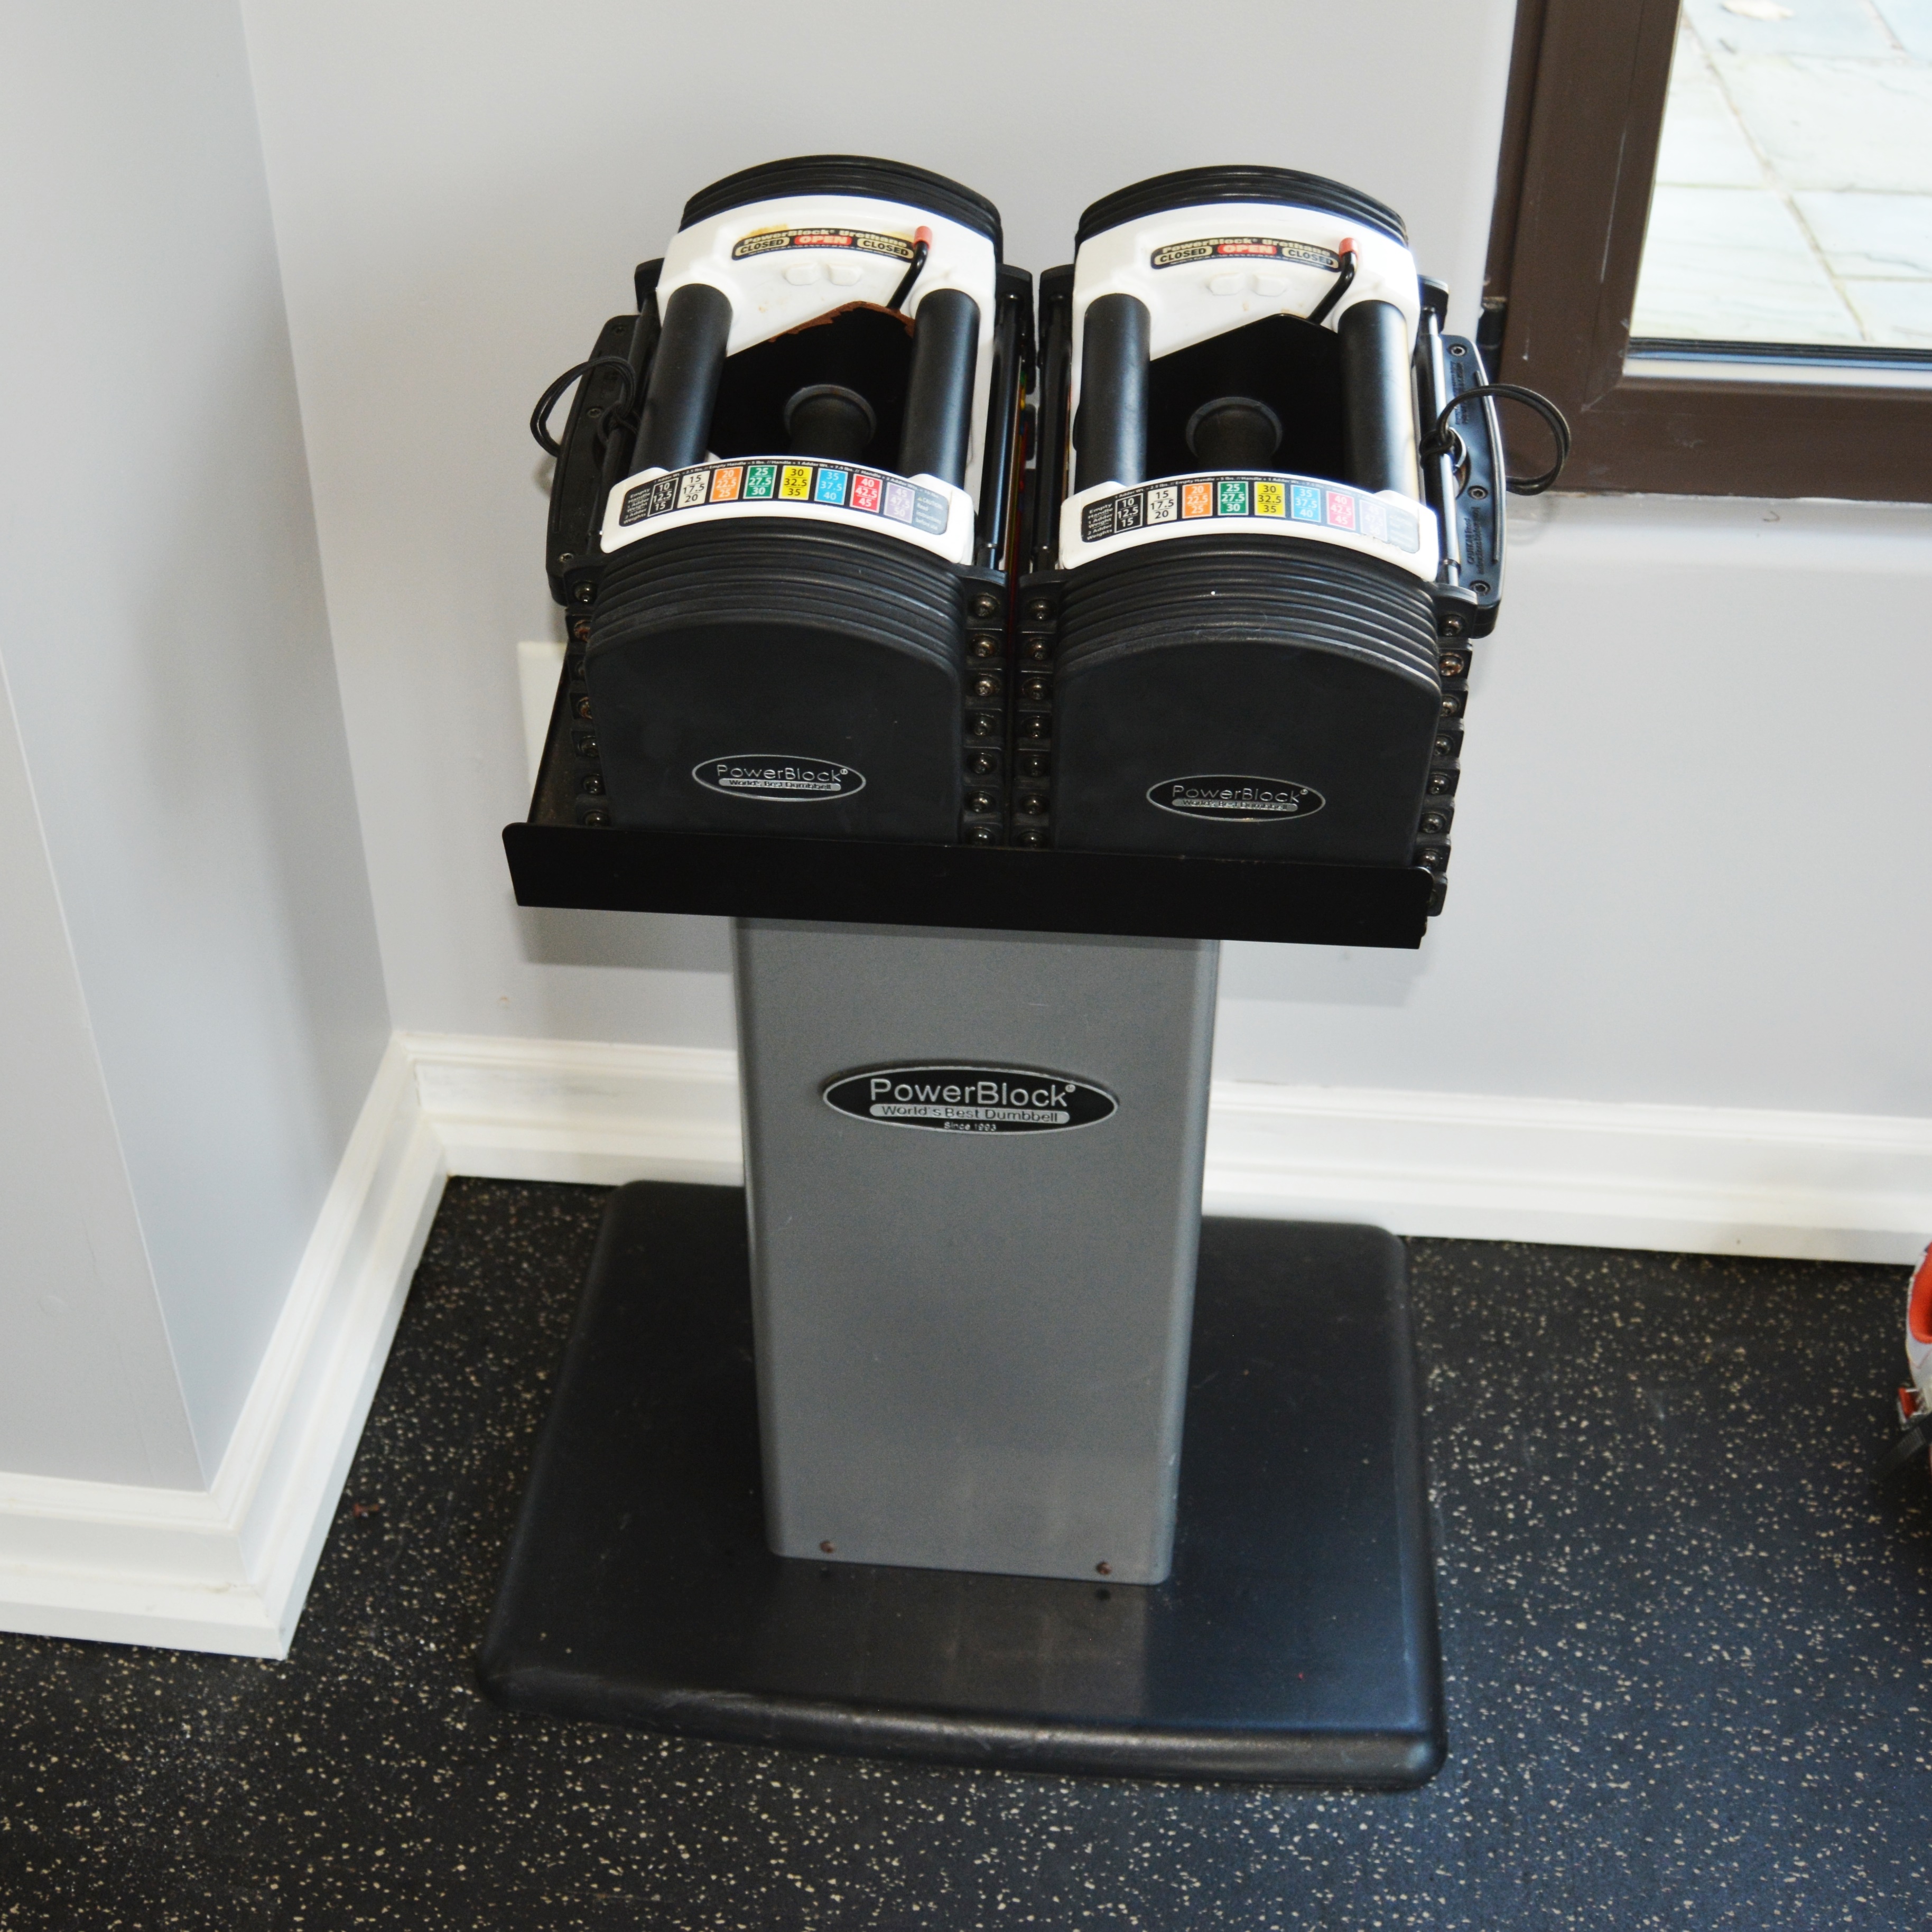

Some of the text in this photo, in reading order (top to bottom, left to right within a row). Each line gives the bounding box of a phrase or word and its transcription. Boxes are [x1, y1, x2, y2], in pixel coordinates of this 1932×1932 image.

[799, 236, 848, 244] OPEN
[839, 230, 907, 247] Urethane
[740, 239, 784, 253] CLOSED
[863, 240, 909, 256] CLOSED
[1222, 245, 1274, 253] OPEN
[1262, 239, 1330, 256] Urethane
[1160, 248, 1206, 263] CLOSED
[1288, 249, 1333, 265] CLOSED
[722, 469, 734, 478] 20
[755, 467, 768, 476] 25
[826, 472, 839, 480] 35
[690, 475, 702, 483] 15
[716, 479, 737, 489] 22.5
[748, 477, 772, 486] 27.5
[784, 478, 807, 487] 32.5
[861, 478, 875, 488] 40
[660, 482, 670, 491] 10
[683, 484, 704, 494] 17.5
[820, 481, 842, 491] 37.5
[1192, 485, 1204, 494] 20
[1226, 484, 1240, 492] 25
[630, 488, 651, 499] Empty
[653, 490, 672, 503] 12.5
[823, 491, 837, 500] 40
[855, 487, 877, 498] 42.5
[896, 488, 907, 498] 45
[1156, 490, 1168, 499] 15
[1300, 488, 1312, 497] 35
[628, 493, 651, 503] Handle
[632, 498, 649, 507] Adder
[685, 494, 698, 503] 20
[859, 498, 872, 507] 45
[890, 496, 910, 509] 47.5
[1122, 498, 1135, 507] 10
[1187, 495, 1208, 504] 22.5
[1221, 494, 1245, 502] 27.5
[1258, 495, 1281, 504] 32.5
[1334, 495, 1347, 504] 40
[627, 502, 647, 513] Weight
[655, 501, 666, 511] 15
[1089, 503, 1112, 514] Empty
[1151, 499, 1174, 510] 17.5
[1295, 498, 1317, 509] 37.5
[629, 508, 647, 517] Adder
[894, 508, 905, 517] 50
[1088, 507, 1113, 519] Handle
[1117, 506, 1139, 519] 12.5
[1155, 510, 1168, 519] 20
[1300, 509, 1313, 518] 40
[1331, 505, 1352, 516] 42.5
[623, 513, 646, 524] Weights
[1089, 517, 1111, 528] Weight
[1093, 513, 1113, 523] Adder
[1121, 517, 1134, 527] 15
[1334, 516, 1348, 525] 45
[1092, 524, 1112, 533] Adder
[1086, 529, 1112, 540] Weights
[785, 782, 832, 790] Dumbbell
[1241, 802, 1288, 811] Dumbbell
[881, 1106, 1057, 1123] World's Best Dumbbell
[944, 1121, 997, 1131] Since 1993
